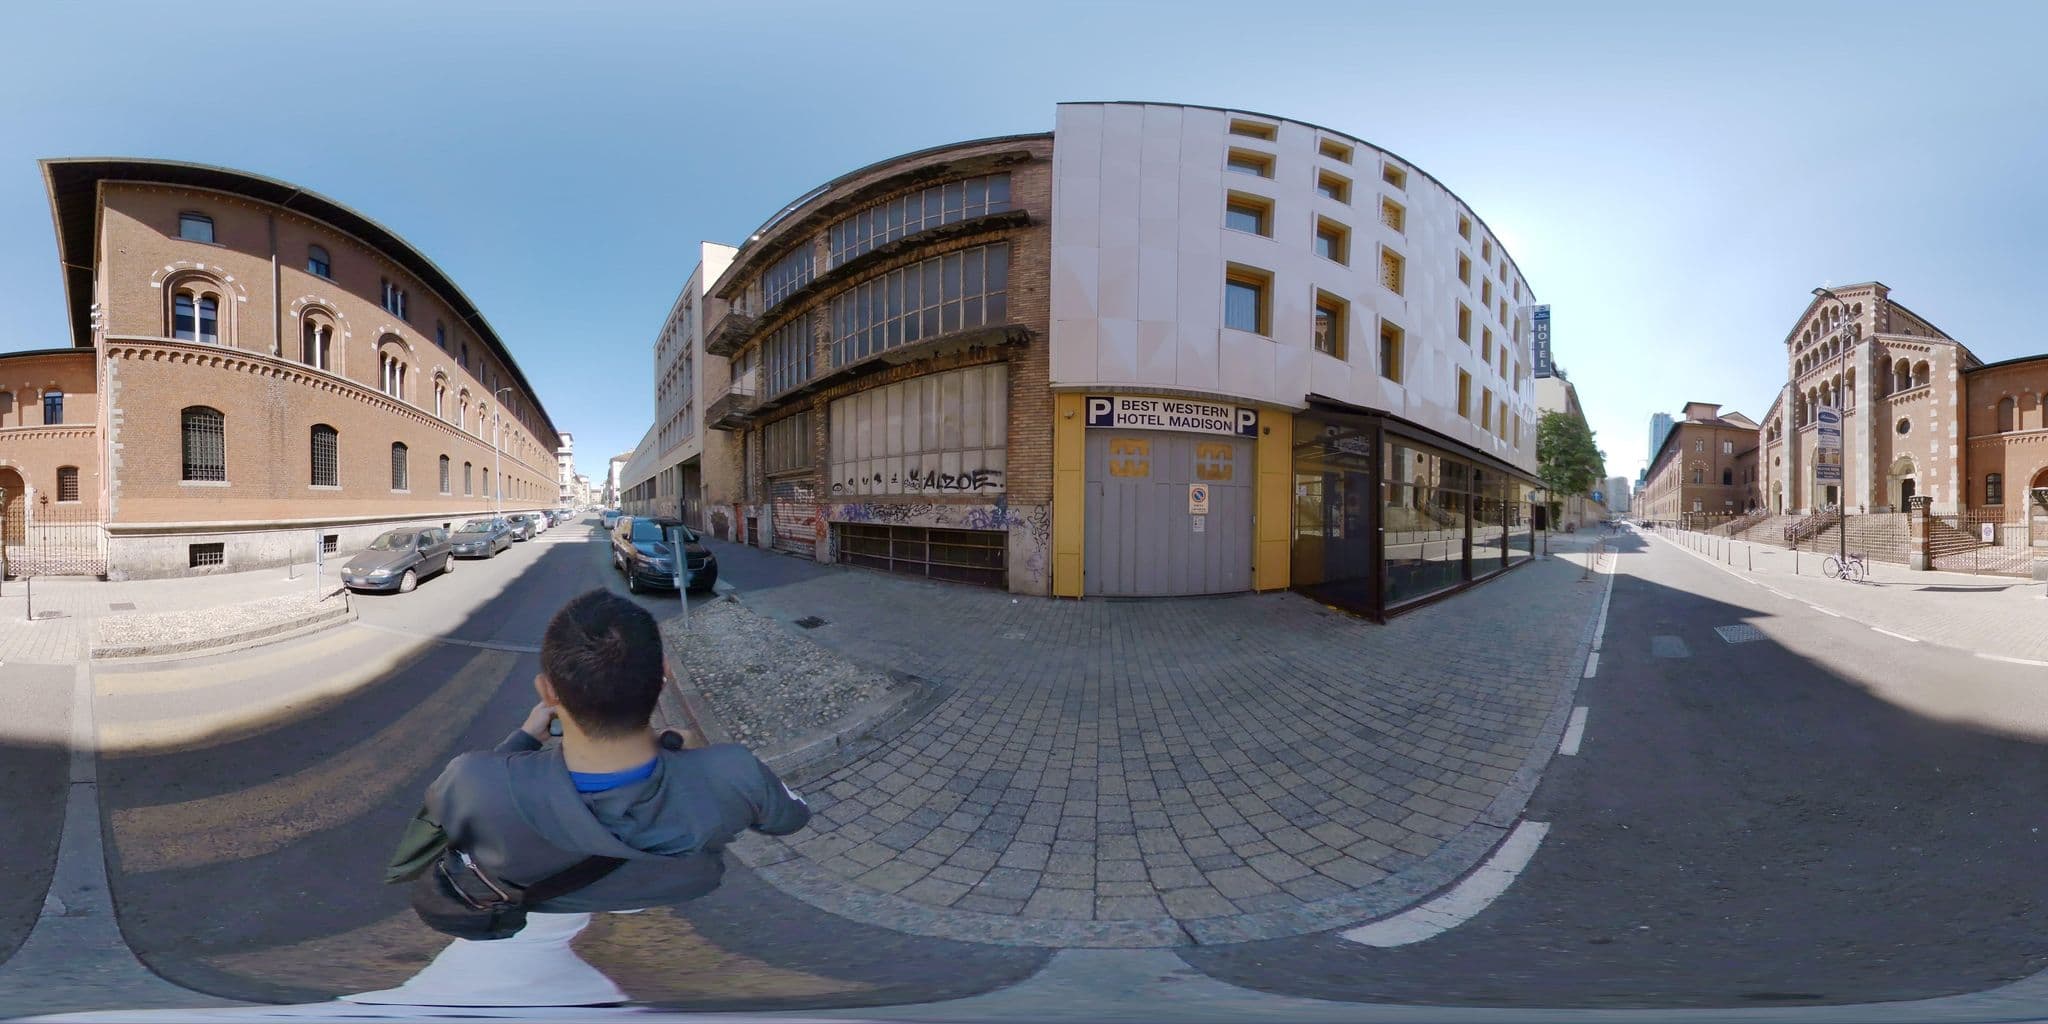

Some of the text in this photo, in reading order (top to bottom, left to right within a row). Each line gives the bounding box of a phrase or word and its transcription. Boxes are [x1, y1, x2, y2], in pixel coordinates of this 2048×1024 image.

[1538, 324, 1547, 367] HOTEL
[1089, 400, 1111, 424] P
[1121, 400, 1229, 417] BEST WESTERN
[1117, 413, 1232, 431] HOTEL MADISON
[1237, 411, 1256, 433] P
